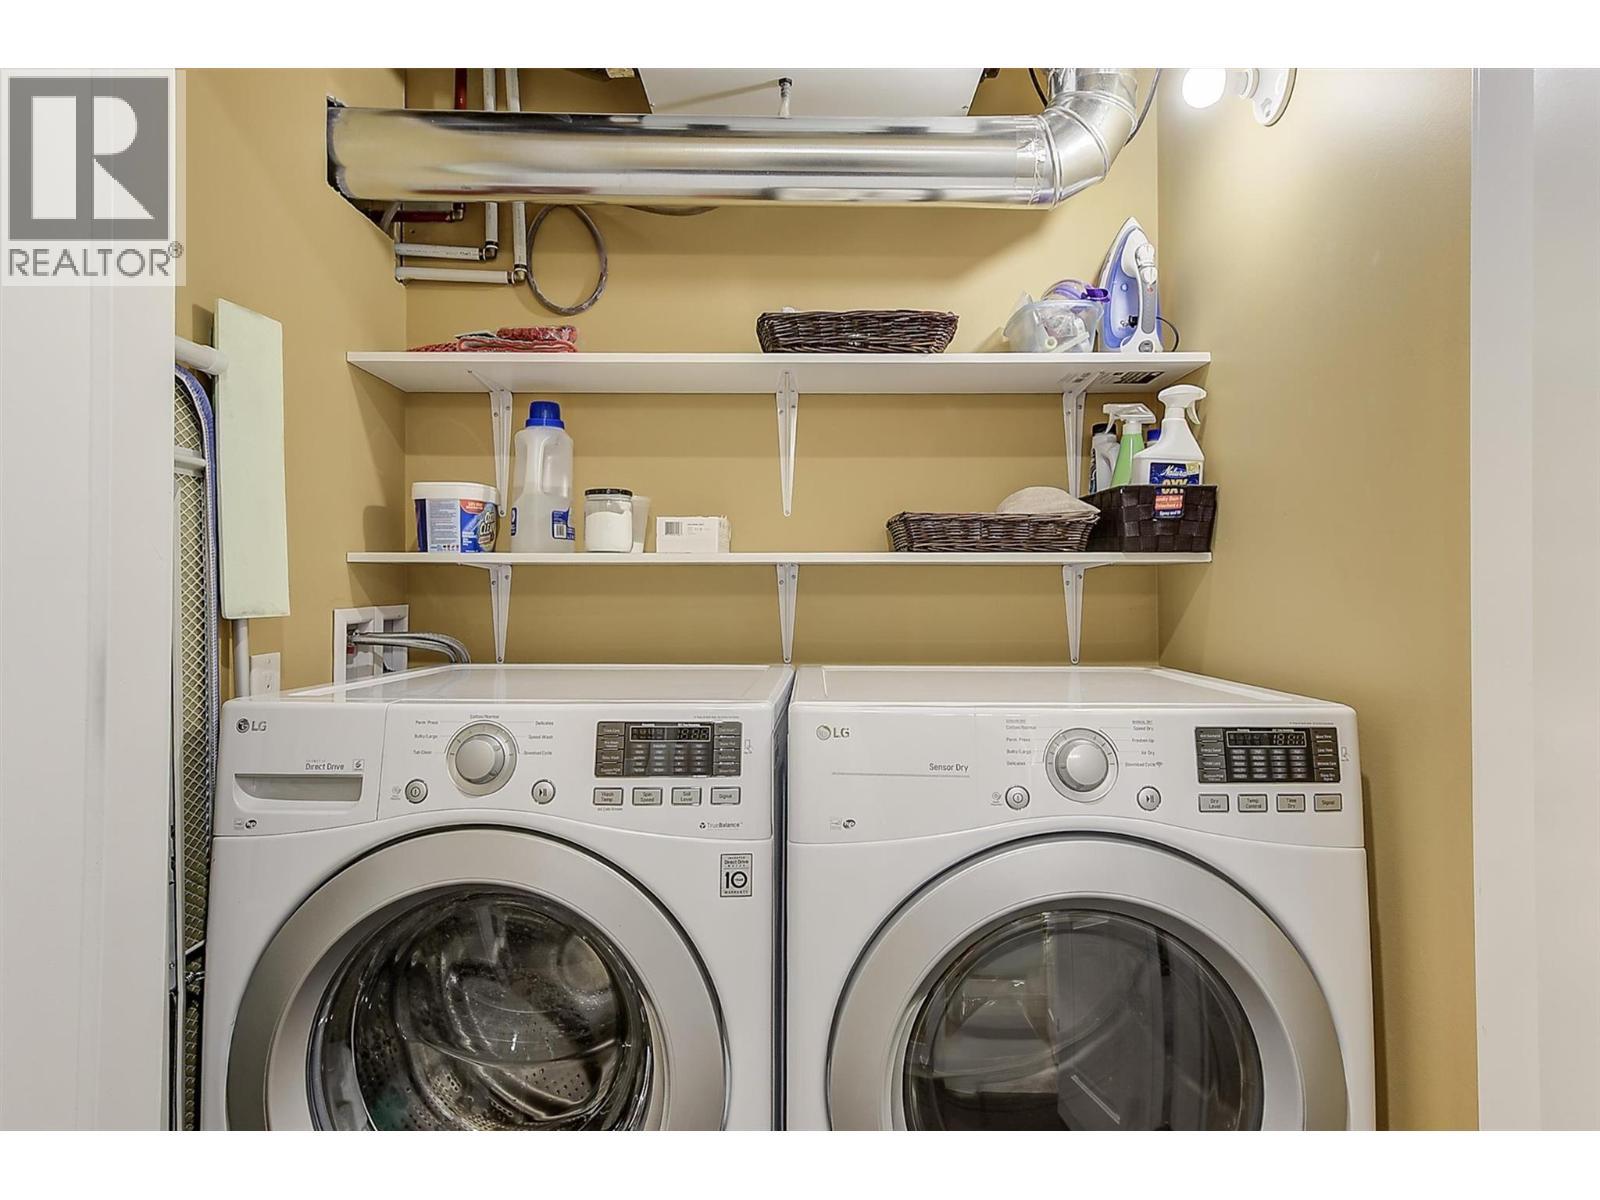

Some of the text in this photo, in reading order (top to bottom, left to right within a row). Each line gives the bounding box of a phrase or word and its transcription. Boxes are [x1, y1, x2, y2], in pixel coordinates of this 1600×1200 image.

[251, 720, 268, 732] LG
[833, 727, 850, 739] LG
[305, 762, 345, 770] Direct Drive
[929, 762, 969, 773] Sensor Dry
[725, 871, 748, 889] 10
